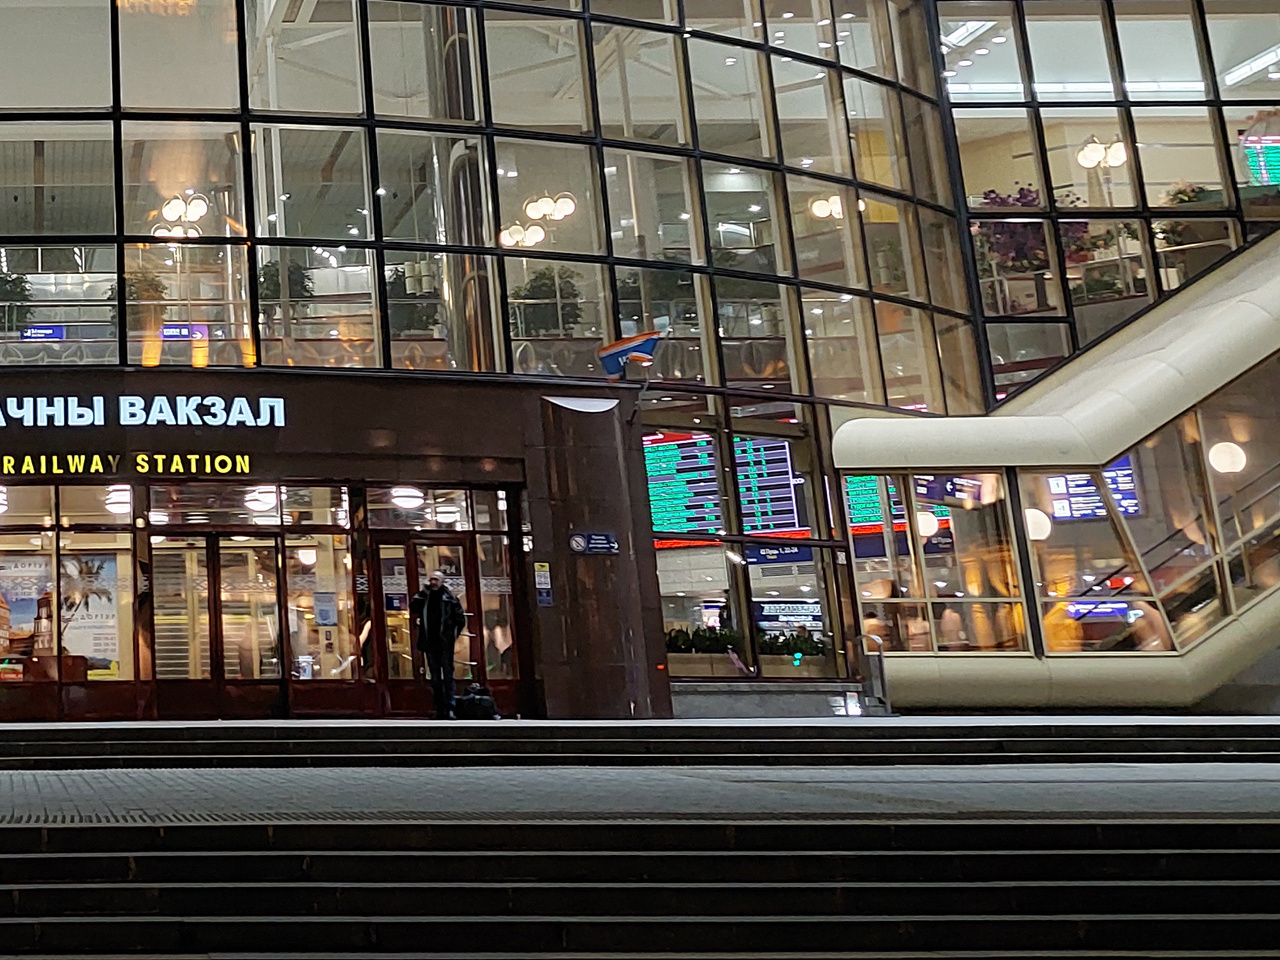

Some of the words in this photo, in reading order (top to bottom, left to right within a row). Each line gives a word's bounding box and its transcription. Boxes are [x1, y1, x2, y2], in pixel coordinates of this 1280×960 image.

[119, 395, 286, 427] ВАКЗАЛ
[2, 454, 120, 475] RAILWAY
[136, 453, 251, 474] STATION
